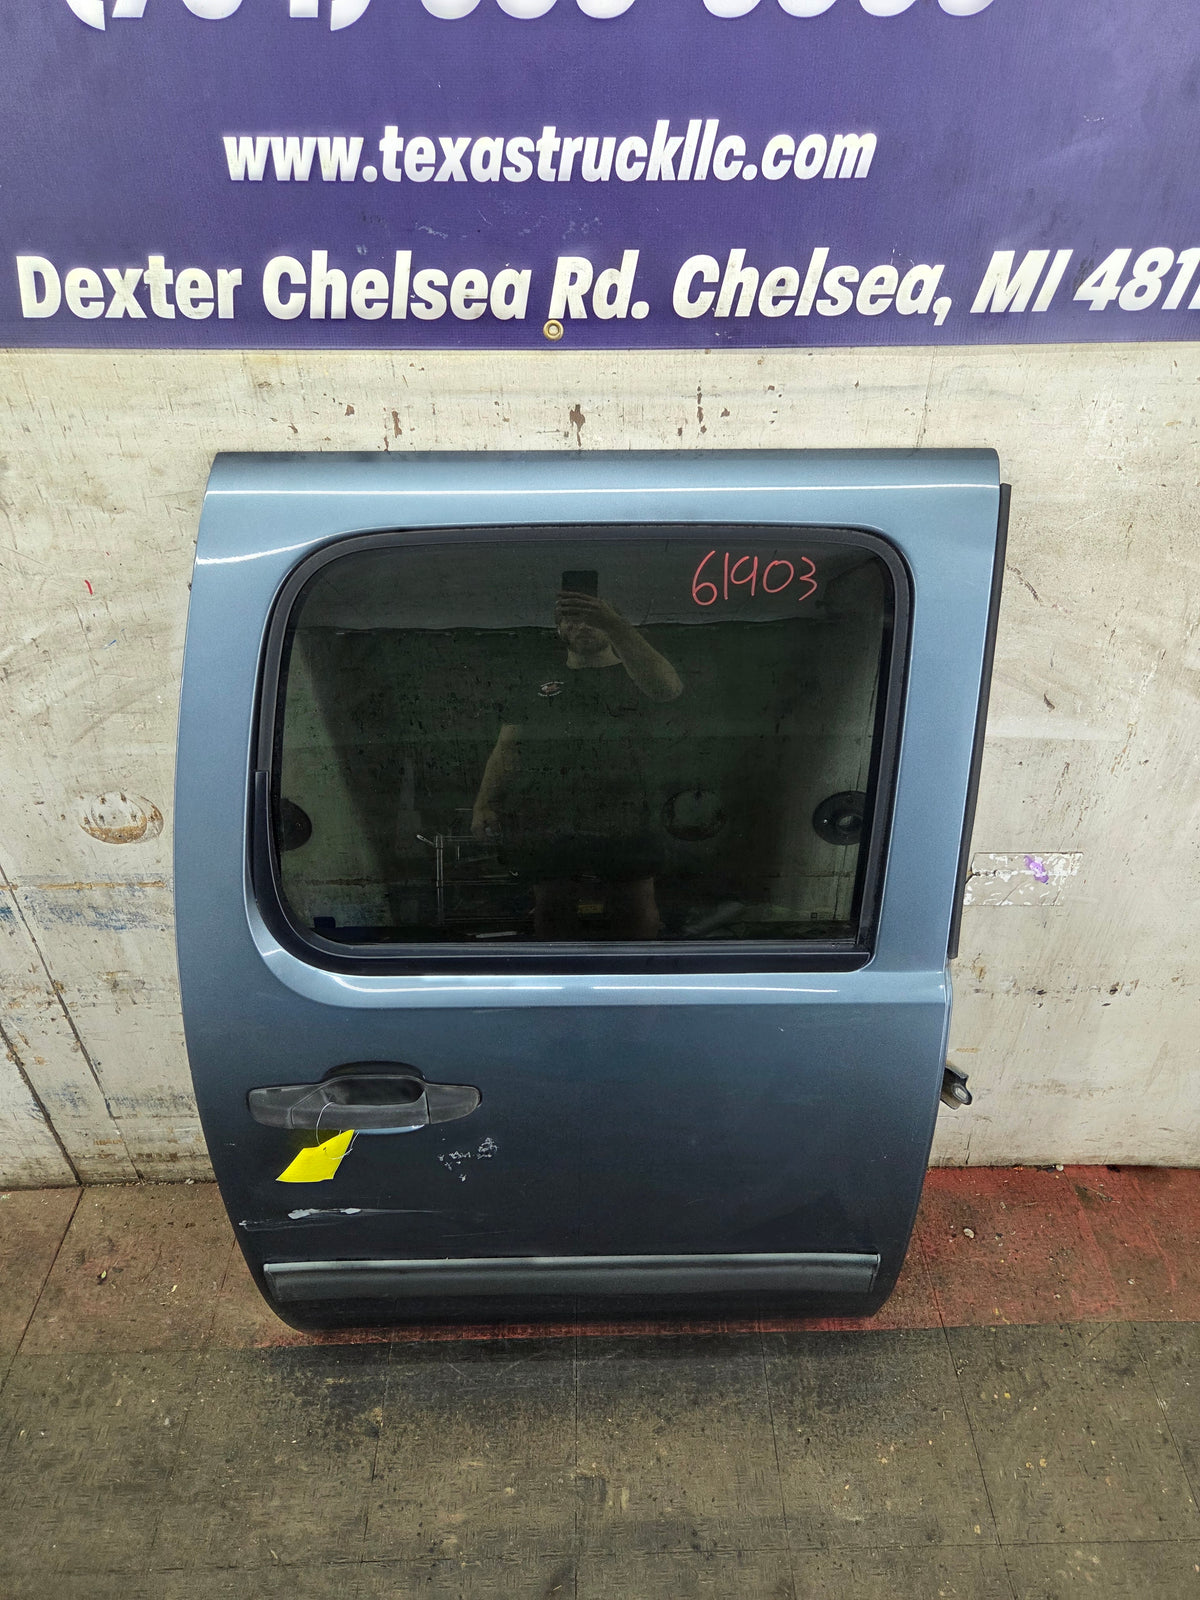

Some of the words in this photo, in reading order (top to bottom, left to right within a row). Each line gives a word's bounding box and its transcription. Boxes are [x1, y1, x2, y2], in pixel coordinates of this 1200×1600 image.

[221, 118, 879, 183] www.texastruckllc.com
[14, 249, 244, 321] Dexter
[262, 249, 533, 322] Chelsea
[547, 248, 650, 320] Rd.
[672, 246, 952, 327] Chelsea,
[969, 248, 1074, 314] MI
[1072, 246, 1200, 312] 481
[691, 549, 818, 607] 61903
